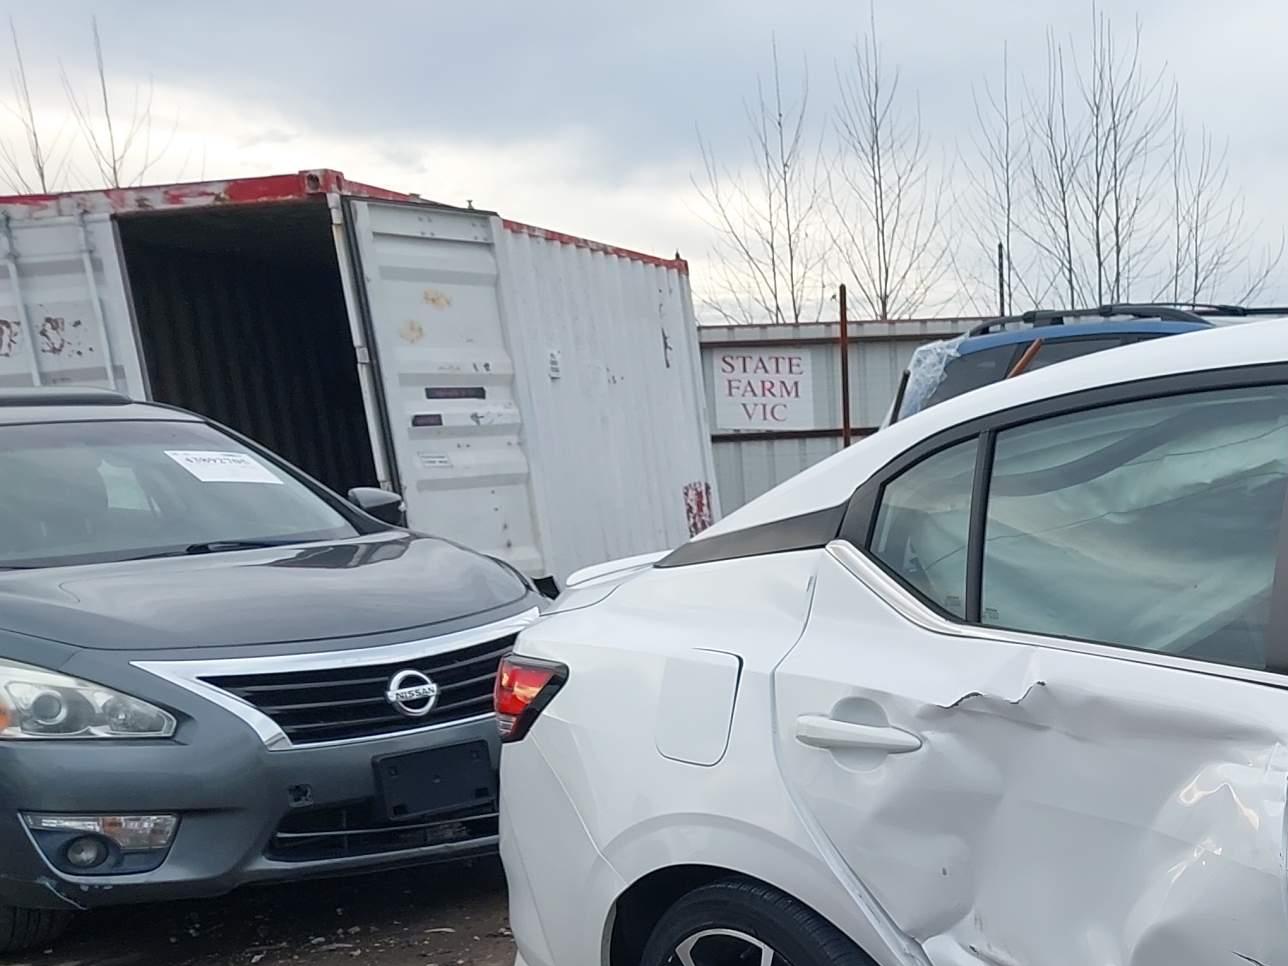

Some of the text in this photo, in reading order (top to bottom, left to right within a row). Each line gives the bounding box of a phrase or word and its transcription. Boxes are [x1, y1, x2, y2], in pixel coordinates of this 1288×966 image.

[721, 355, 804, 375] STATE
[727, 379, 800, 398] FARM
[741, 403, 787, 422] VIC
[395, 686, 435, 700] NISSAN
